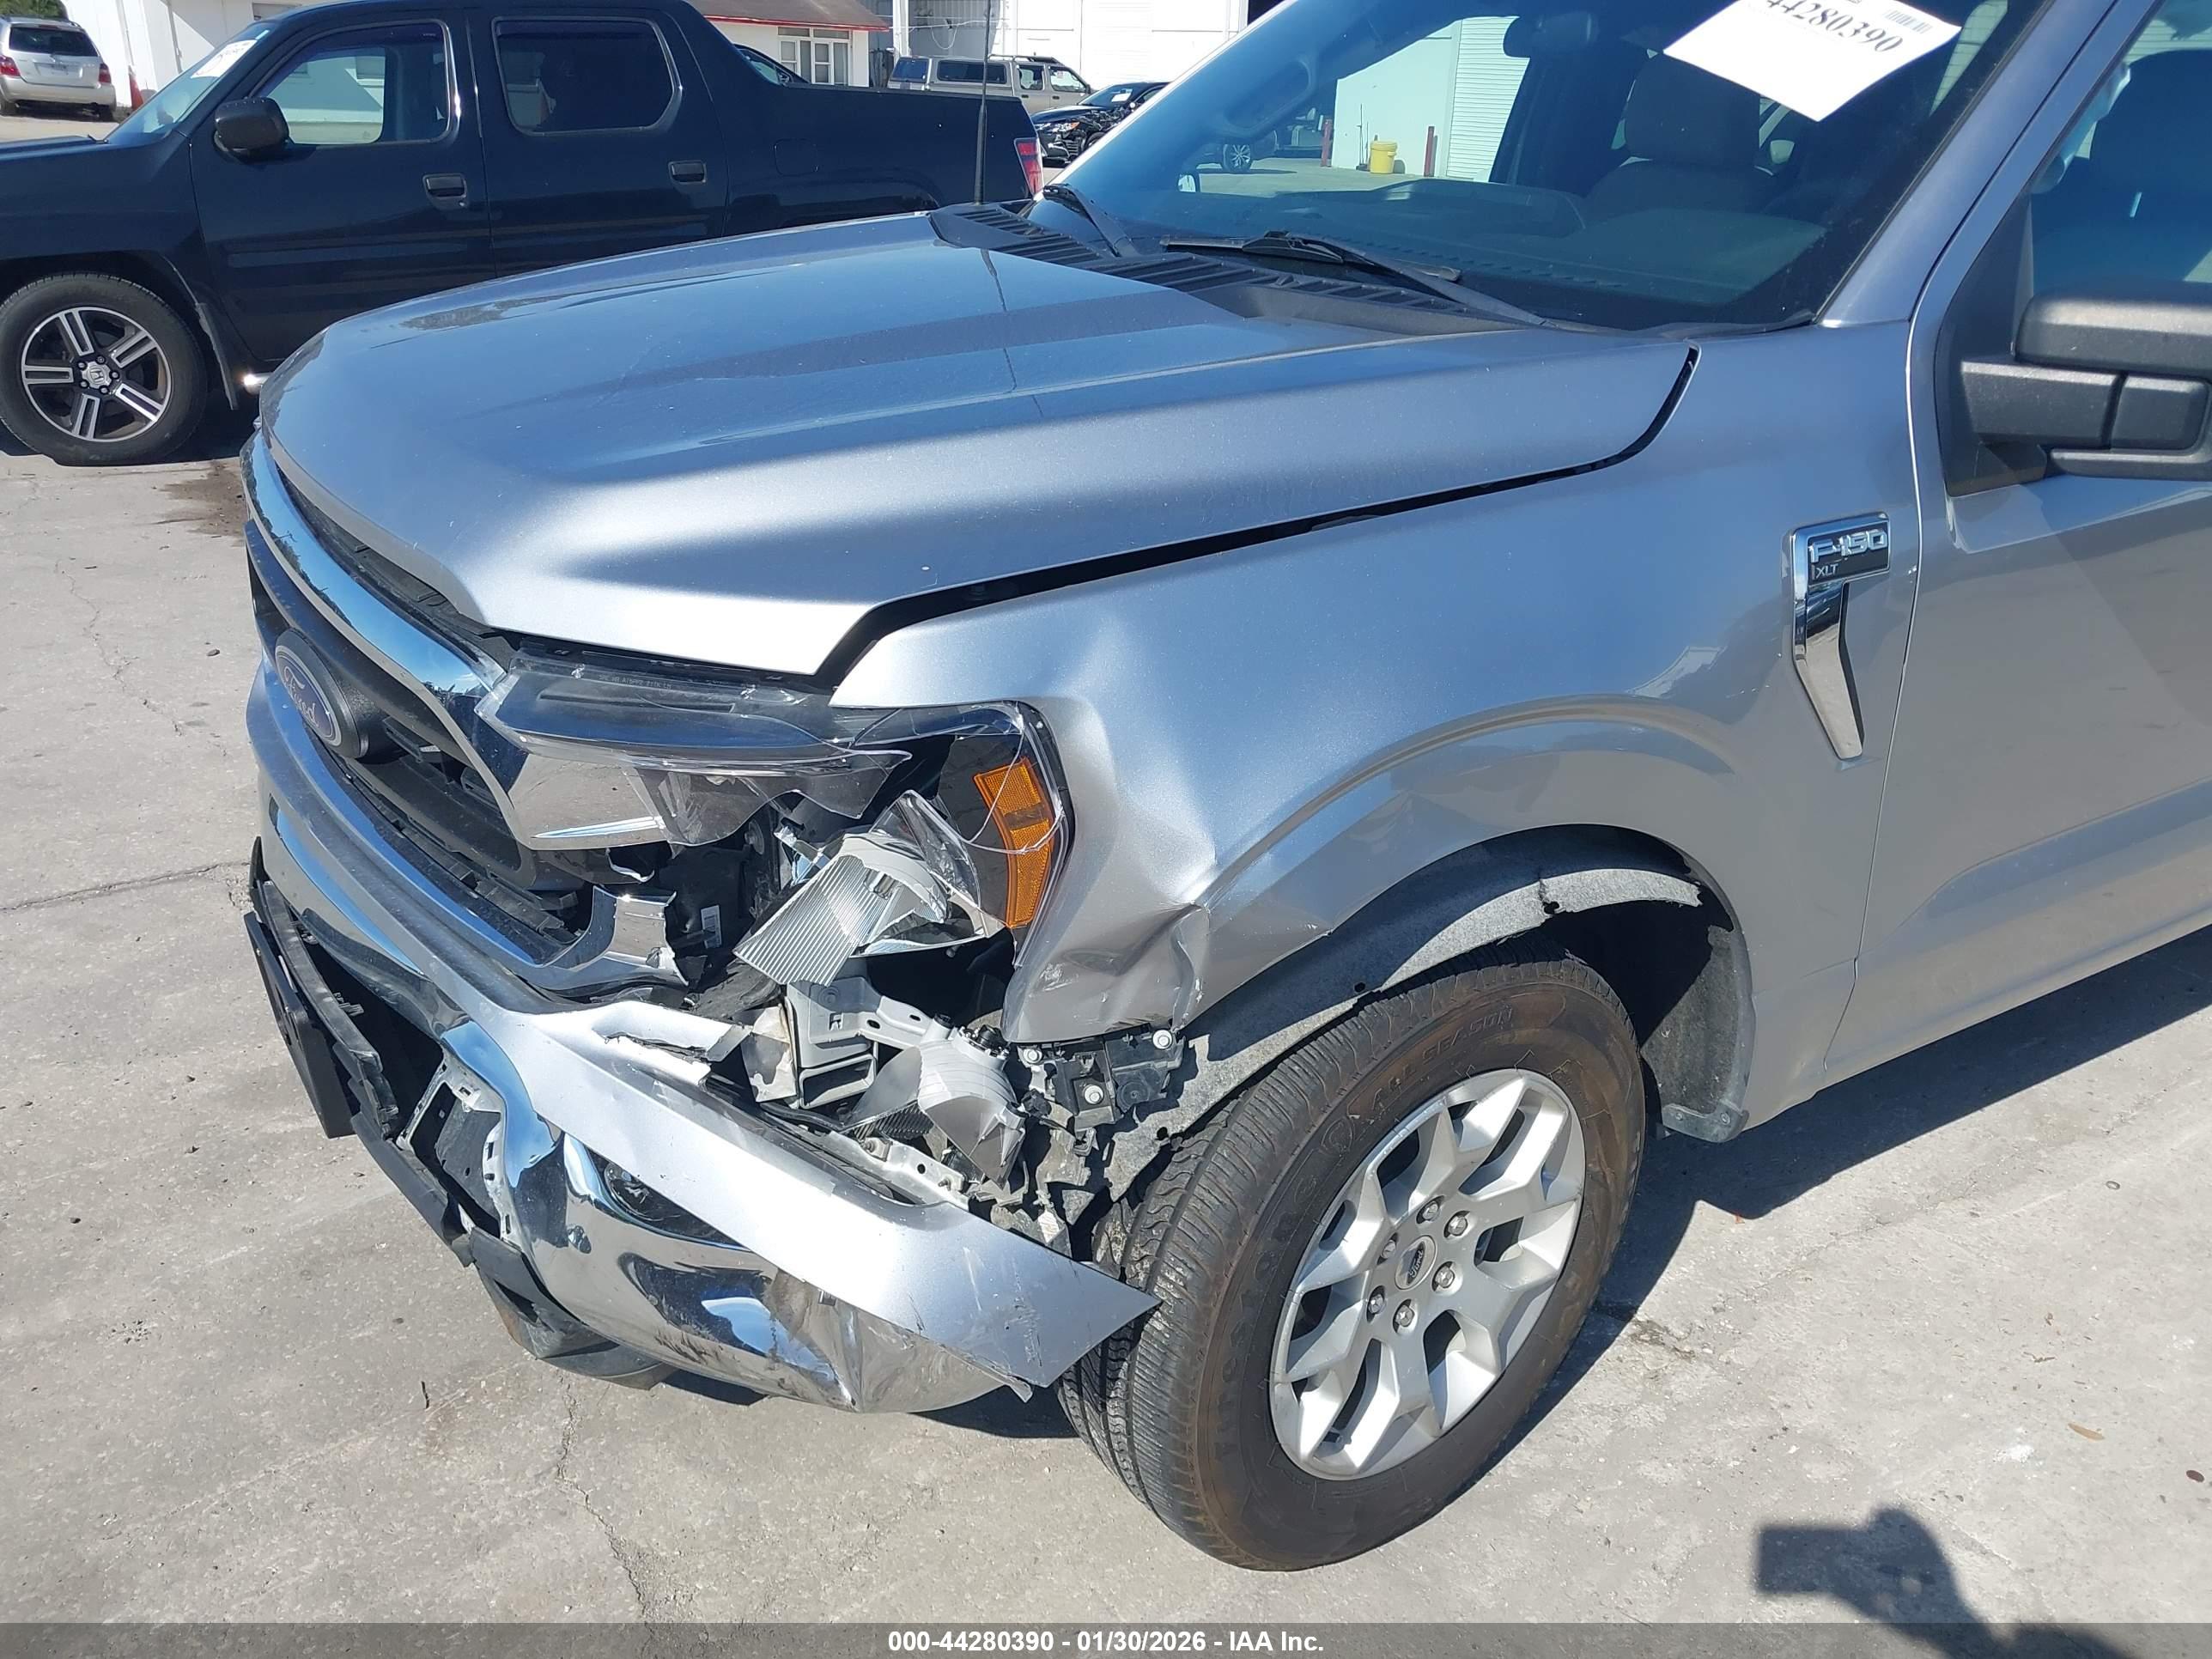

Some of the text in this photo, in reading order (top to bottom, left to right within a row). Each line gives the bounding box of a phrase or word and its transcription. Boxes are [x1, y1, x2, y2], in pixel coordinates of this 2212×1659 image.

[1808, 529, 1888, 563] F-150
[1815, 563, 1838, 580] XLT
[284, 665, 319, 729] Ford
[1409, 1249, 1424, 1278] Ford
